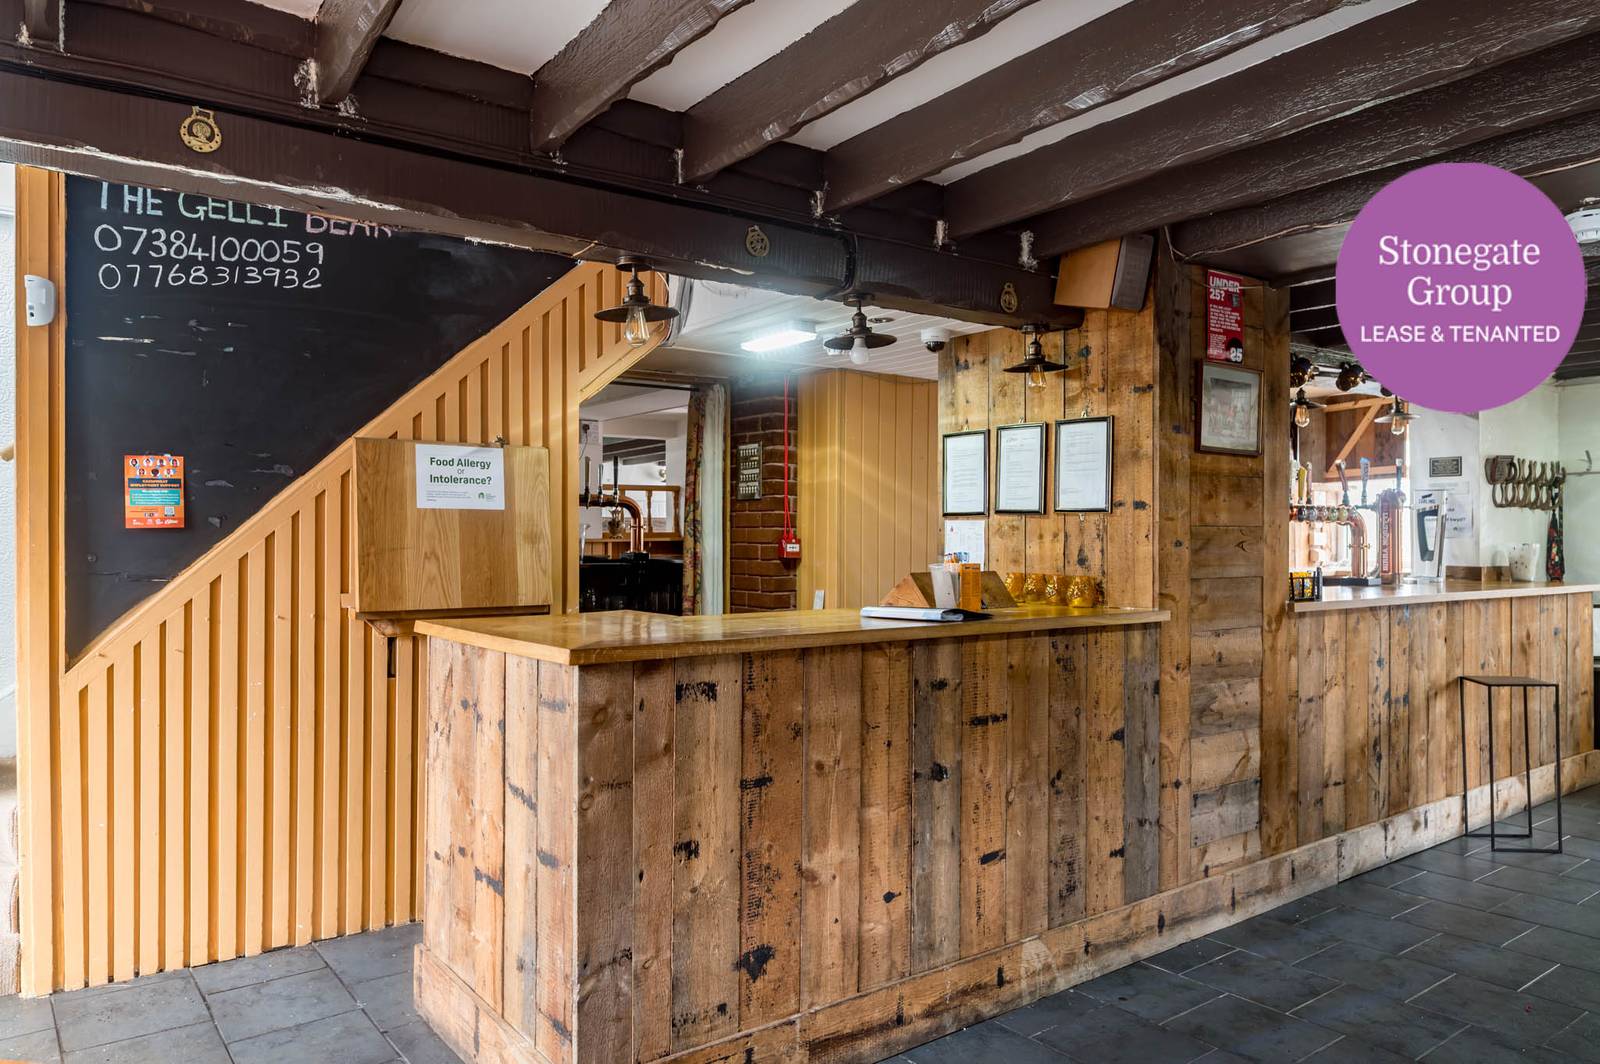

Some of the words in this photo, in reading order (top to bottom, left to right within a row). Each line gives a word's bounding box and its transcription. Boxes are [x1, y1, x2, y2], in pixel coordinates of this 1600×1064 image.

[177, 192, 288, 228] GELLI
[93, 224, 325, 266] 07384100059
[98, 263, 322, 290] 07768313932
[1209, 275, 1240, 293] UNDER
[430, 457, 455, 467] Food
[456, 458, 491, 470] Allergy
[429, 474, 492, 485] Intolerance?
